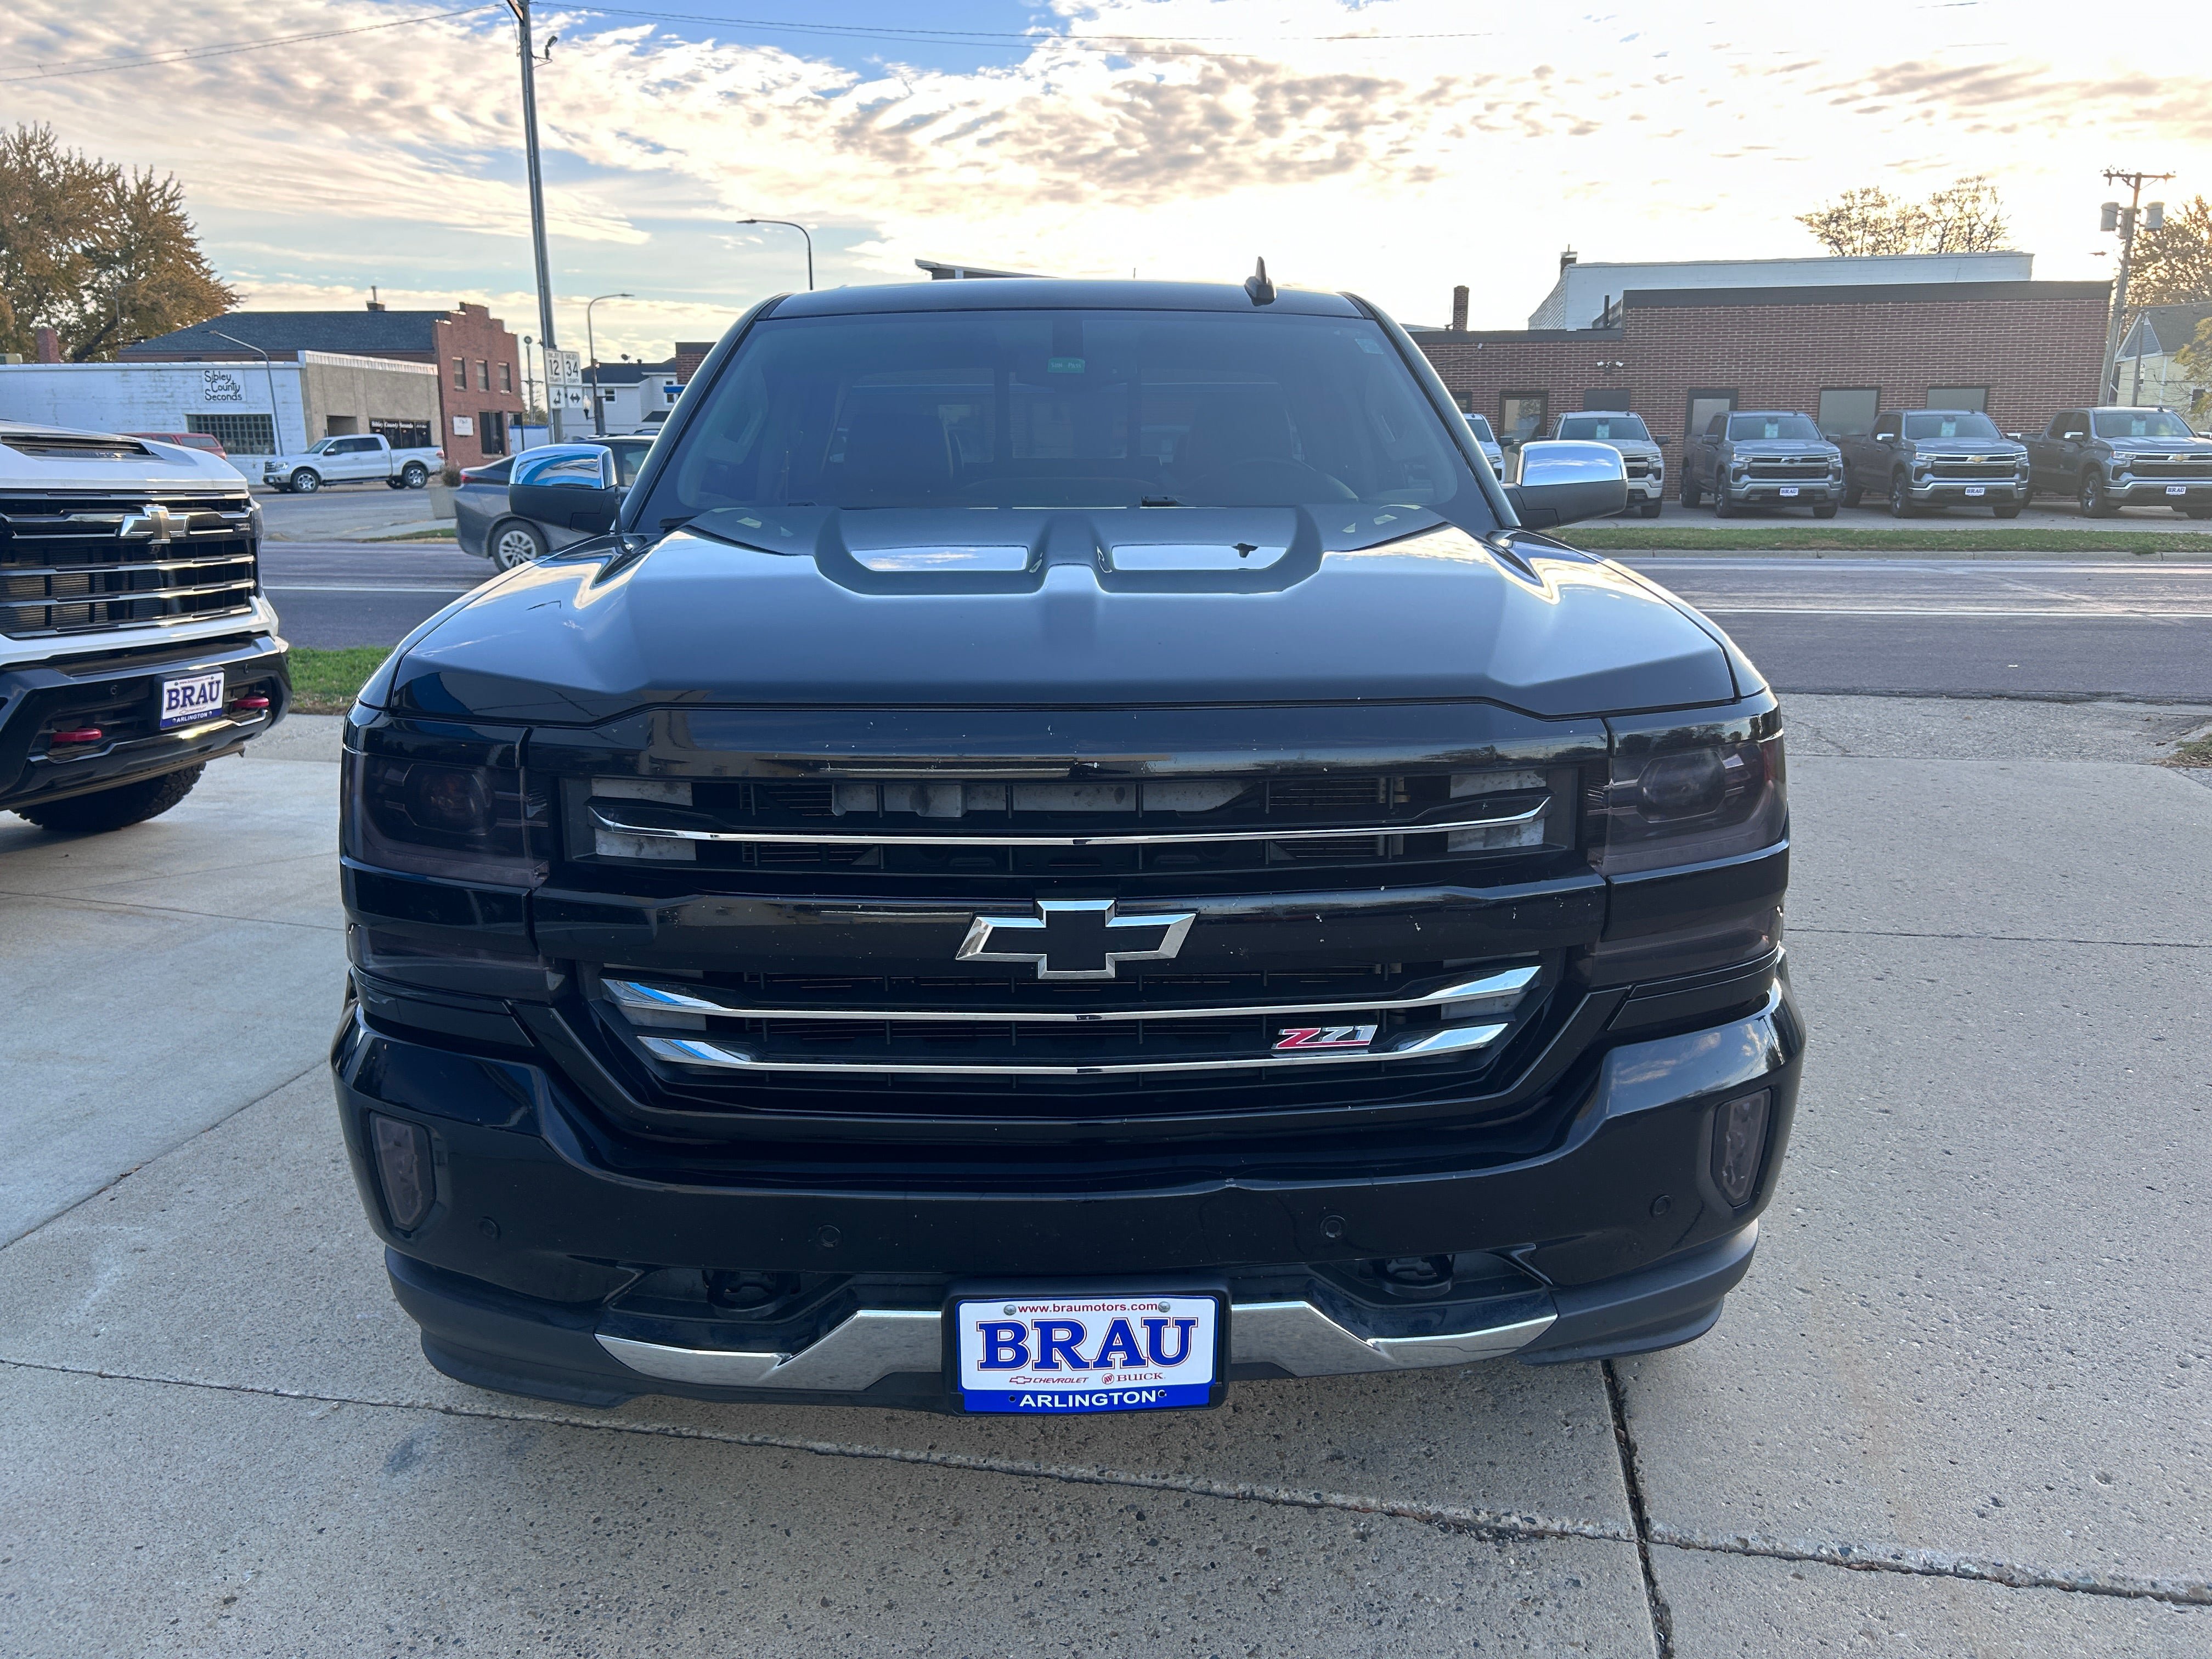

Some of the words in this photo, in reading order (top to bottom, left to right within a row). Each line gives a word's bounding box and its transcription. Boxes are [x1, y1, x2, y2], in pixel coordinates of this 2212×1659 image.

[549, 359, 560, 375] 12
[566, 360, 578, 377] 34
[205, 370, 231, 384] Sibley
[205, 388, 242, 400] Seconds
[211, 380, 240, 394] County
[166, 680, 221, 712] BRAU
[176, 712, 208, 723] ARLINGTON
[1271, 1024, 1378, 1049] Z71
[1018, 1302, 1158, 1313] www.braumotors.com
[976, 1317, 1198, 1371] BRAU
[1116, 1372, 1164, 1381] BUICK
[1019, 1390, 1156, 1408] ARLINGTON
